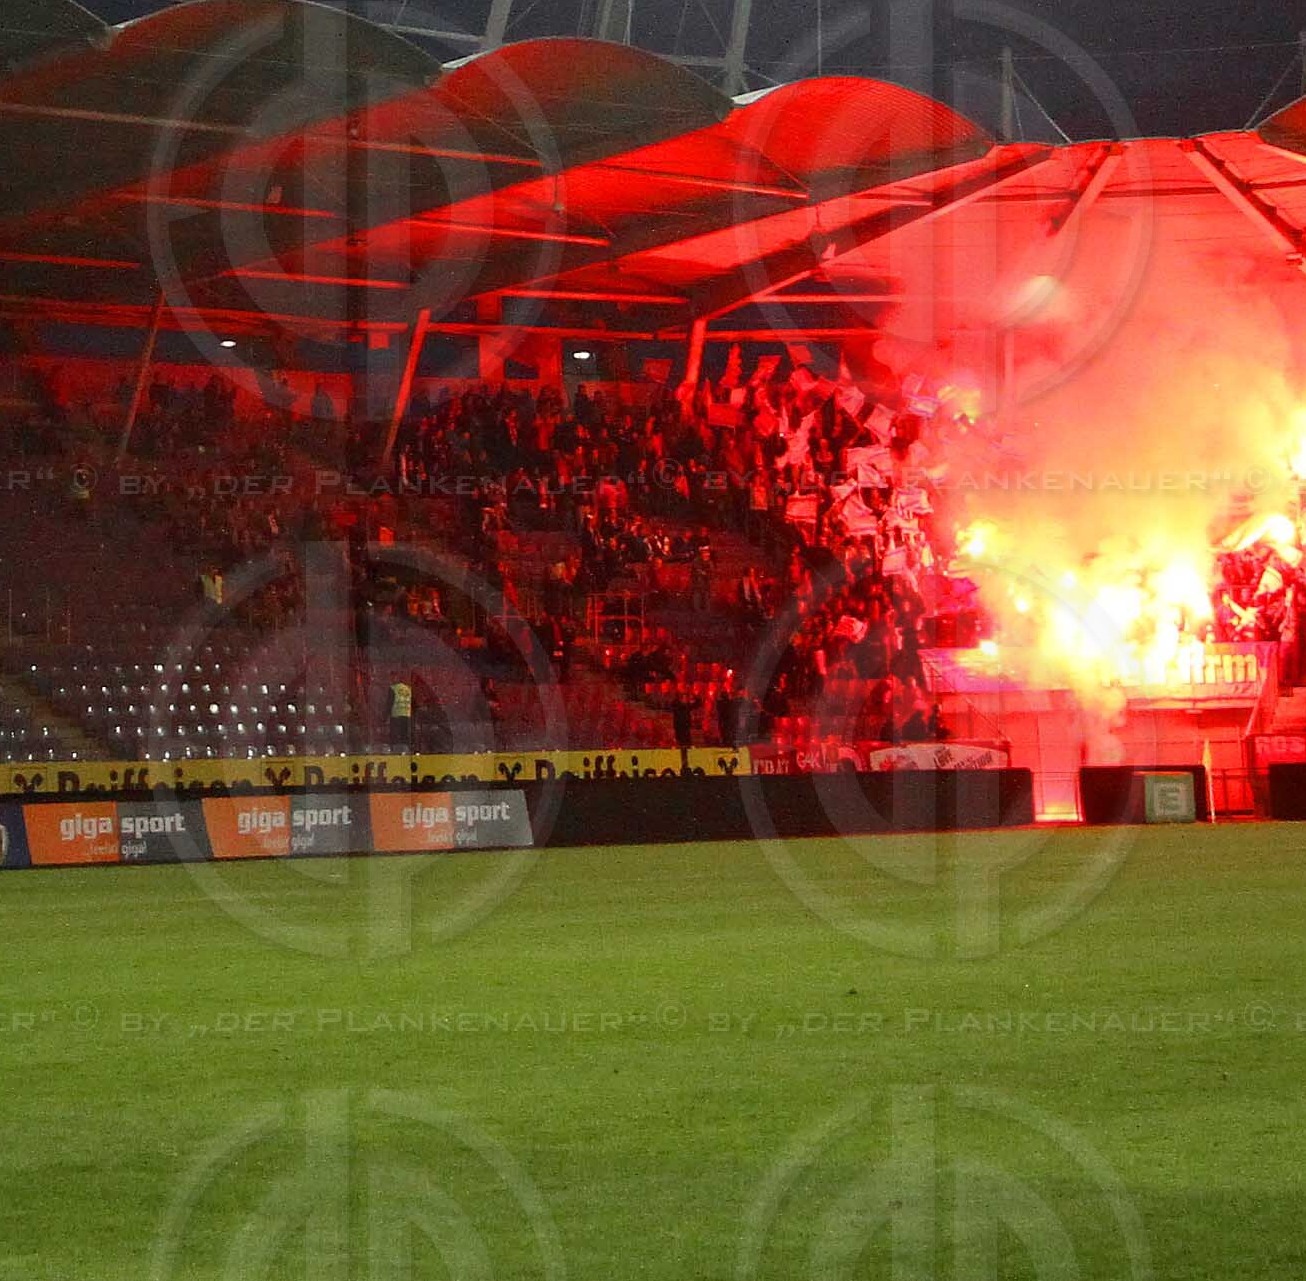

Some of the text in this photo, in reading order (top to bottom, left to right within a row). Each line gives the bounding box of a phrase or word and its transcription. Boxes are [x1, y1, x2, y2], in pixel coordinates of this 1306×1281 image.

[60, 812, 185, 840] giga sport
[237, 805, 352, 833] giga sport
[401, 801, 510, 828] giga sport
